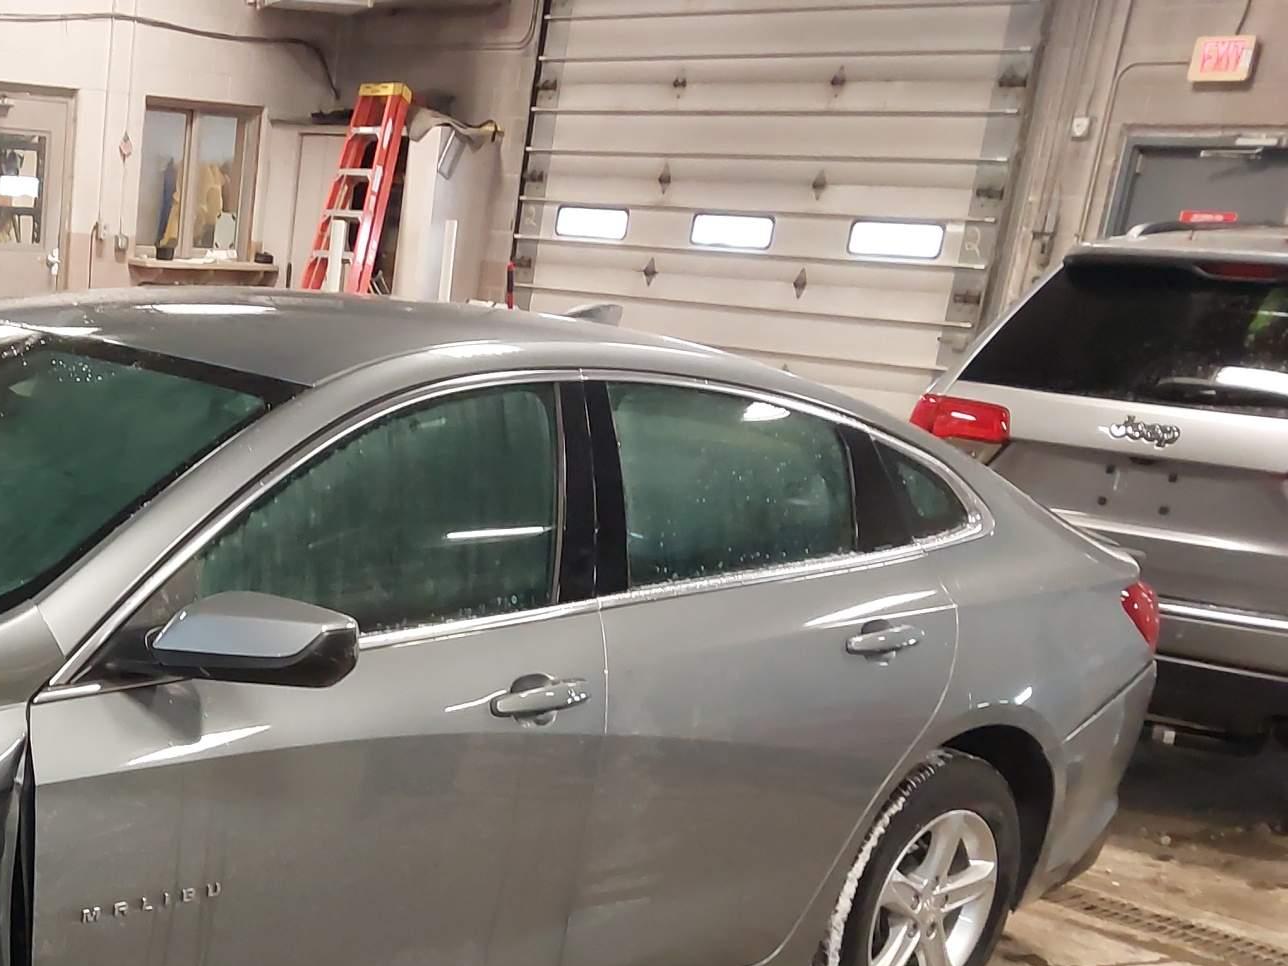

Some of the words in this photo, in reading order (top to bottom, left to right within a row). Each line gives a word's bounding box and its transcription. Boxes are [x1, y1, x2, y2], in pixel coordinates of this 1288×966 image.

[1199, 40, 1246, 74] EXIT
[1097, 415, 1181, 448] Jeep
[80, 881, 221, 924] MALIBU
